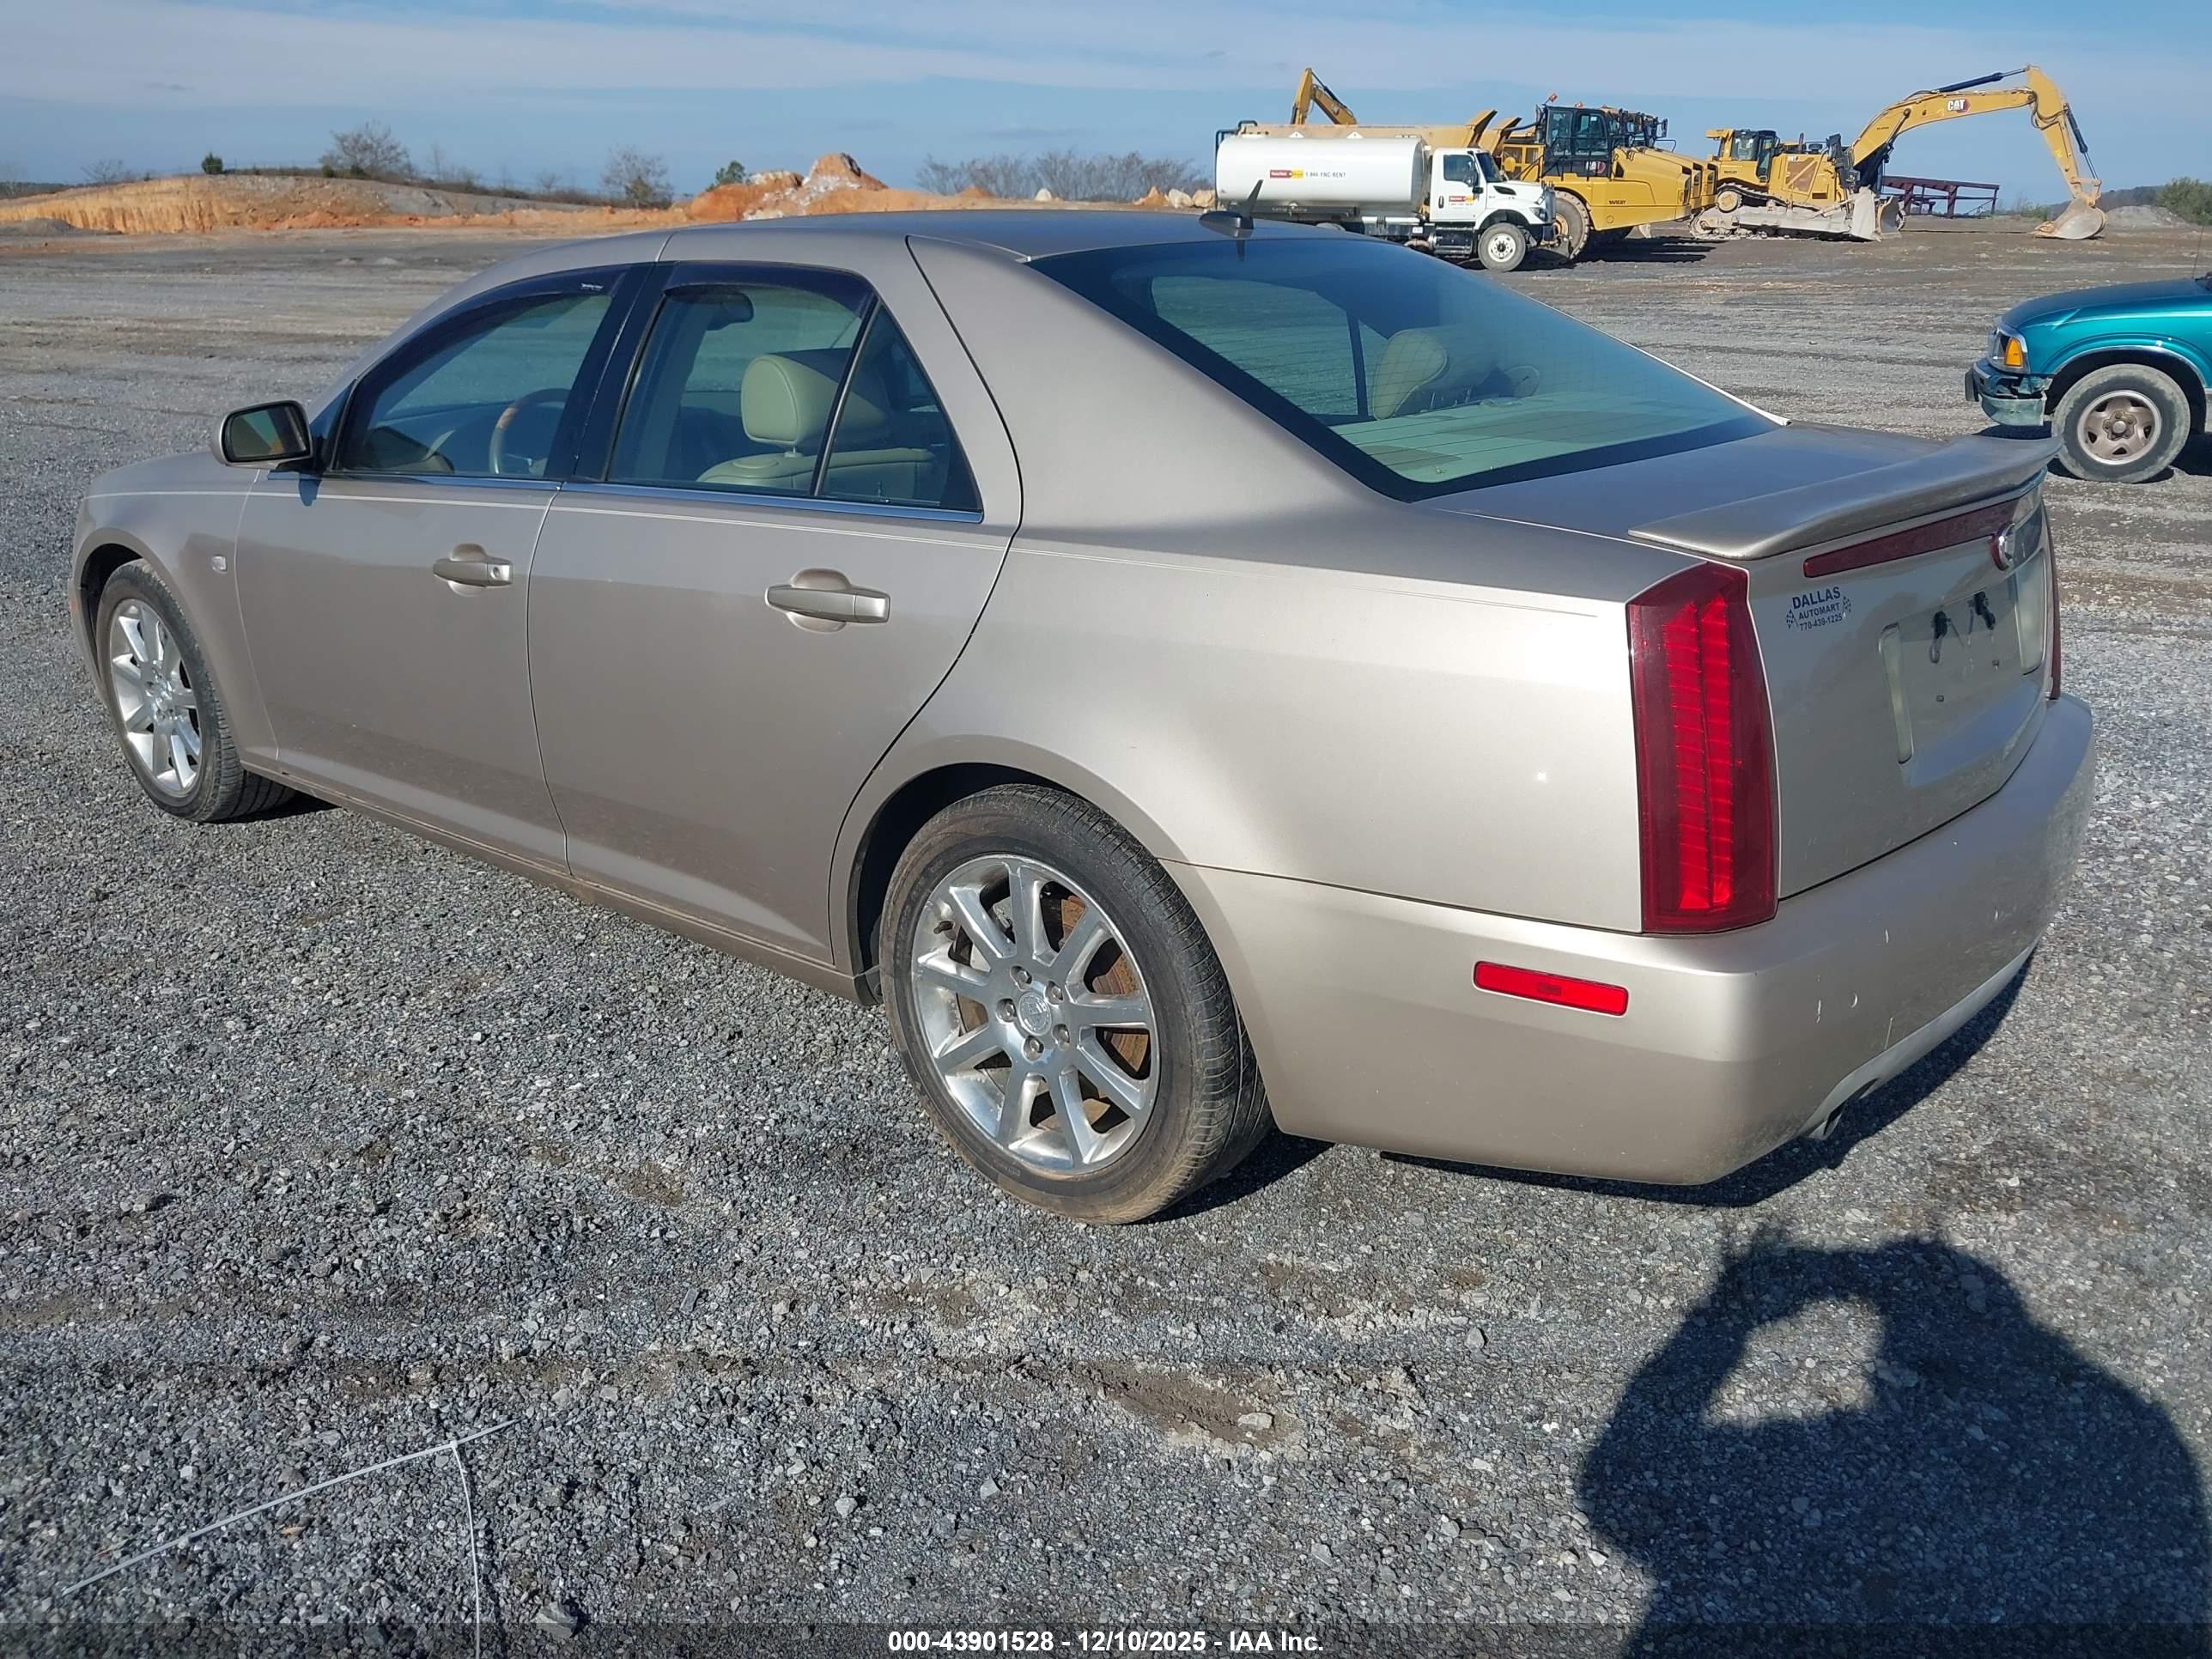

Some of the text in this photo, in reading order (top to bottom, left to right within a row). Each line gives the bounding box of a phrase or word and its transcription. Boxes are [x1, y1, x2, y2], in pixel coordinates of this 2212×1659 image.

[1948, 99, 1966, 111] CAT
[1792, 586, 1840, 609] DALLAS
[1799, 603, 1840, 619] AUTOMART
[1799, 613, 1843, 631] 770-439-1225
